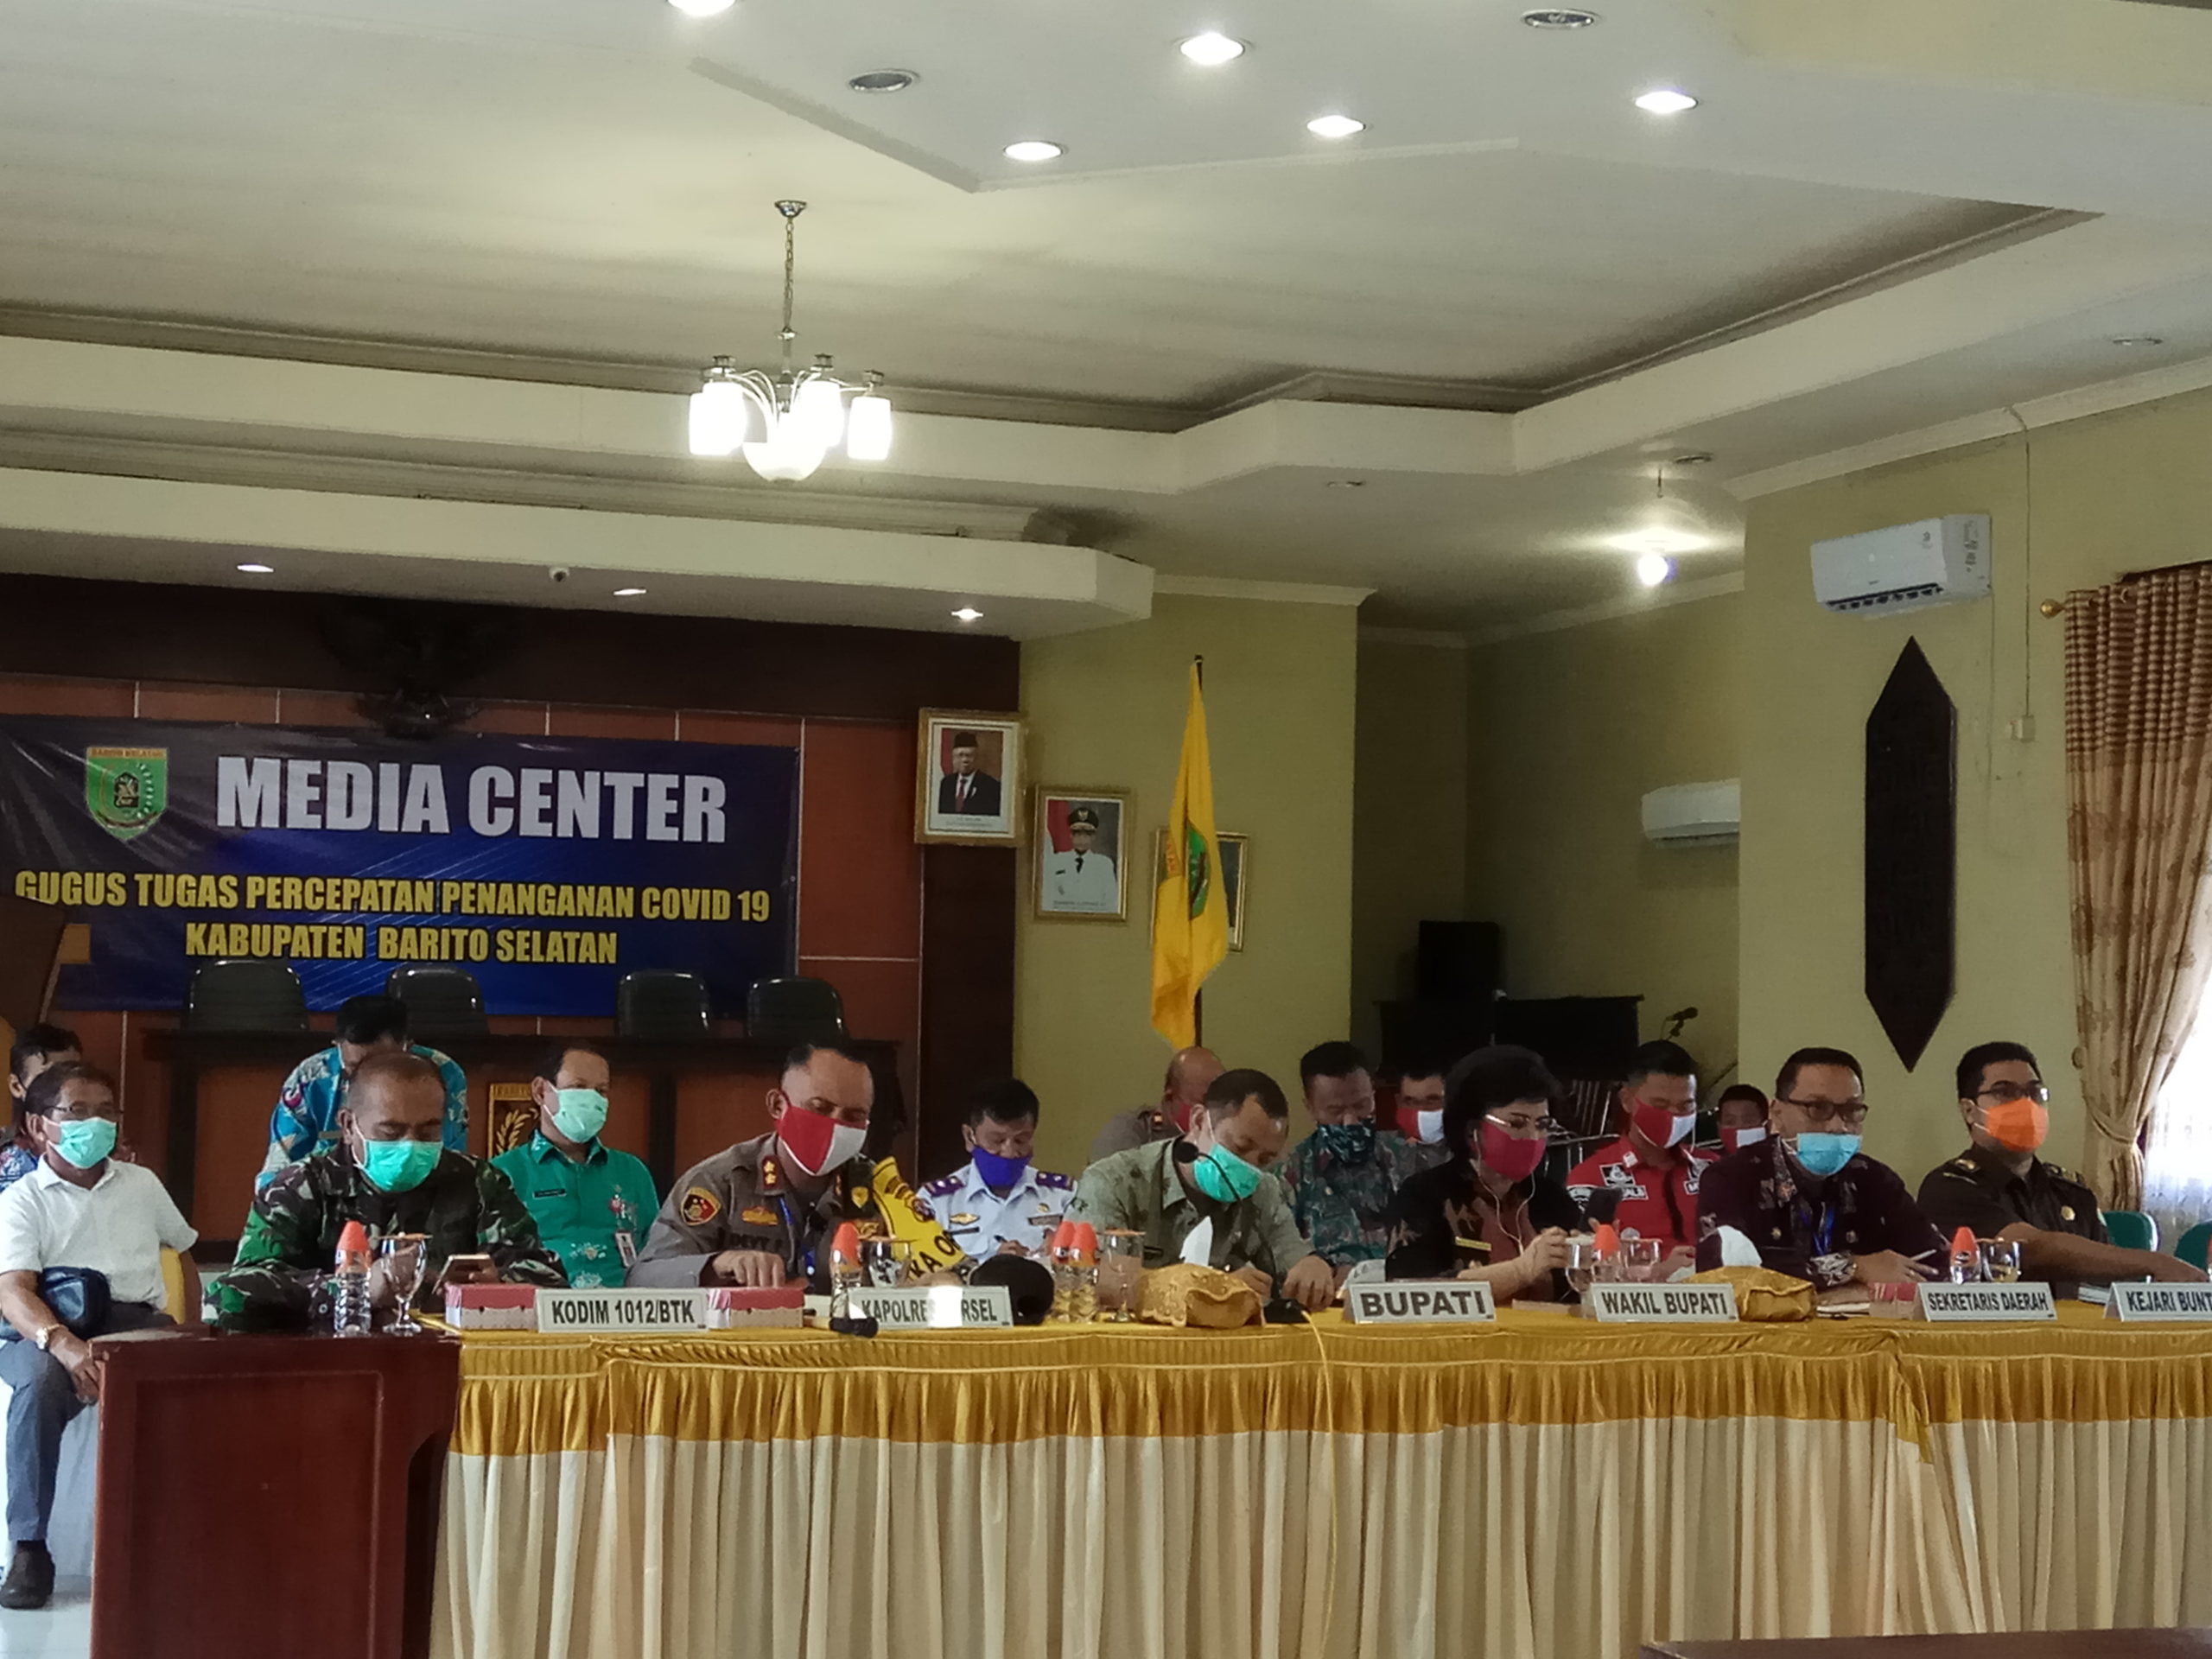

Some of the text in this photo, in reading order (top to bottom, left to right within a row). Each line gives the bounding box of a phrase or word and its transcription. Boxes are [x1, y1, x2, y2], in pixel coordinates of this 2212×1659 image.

[217, 756, 726, 843] MEDIA CENTER
[15, 870, 770, 922] GUGUS TUGAS PERCEPATAN PENANGANAN COVID 19
[185, 923, 617, 964] KABUPATEN BARITO SELATAN
[552, 1299, 695, 1325] KODIM 1012/BTK
[1360, 1290, 1486, 1317] BUPATI
[1601, 1292, 1727, 1315] WAKIL BUPATI
[1928, 1293, 2049, 1311] SEKRETARIS DAERAH
[2126, 1291, 2177, 1312] KEJARI
